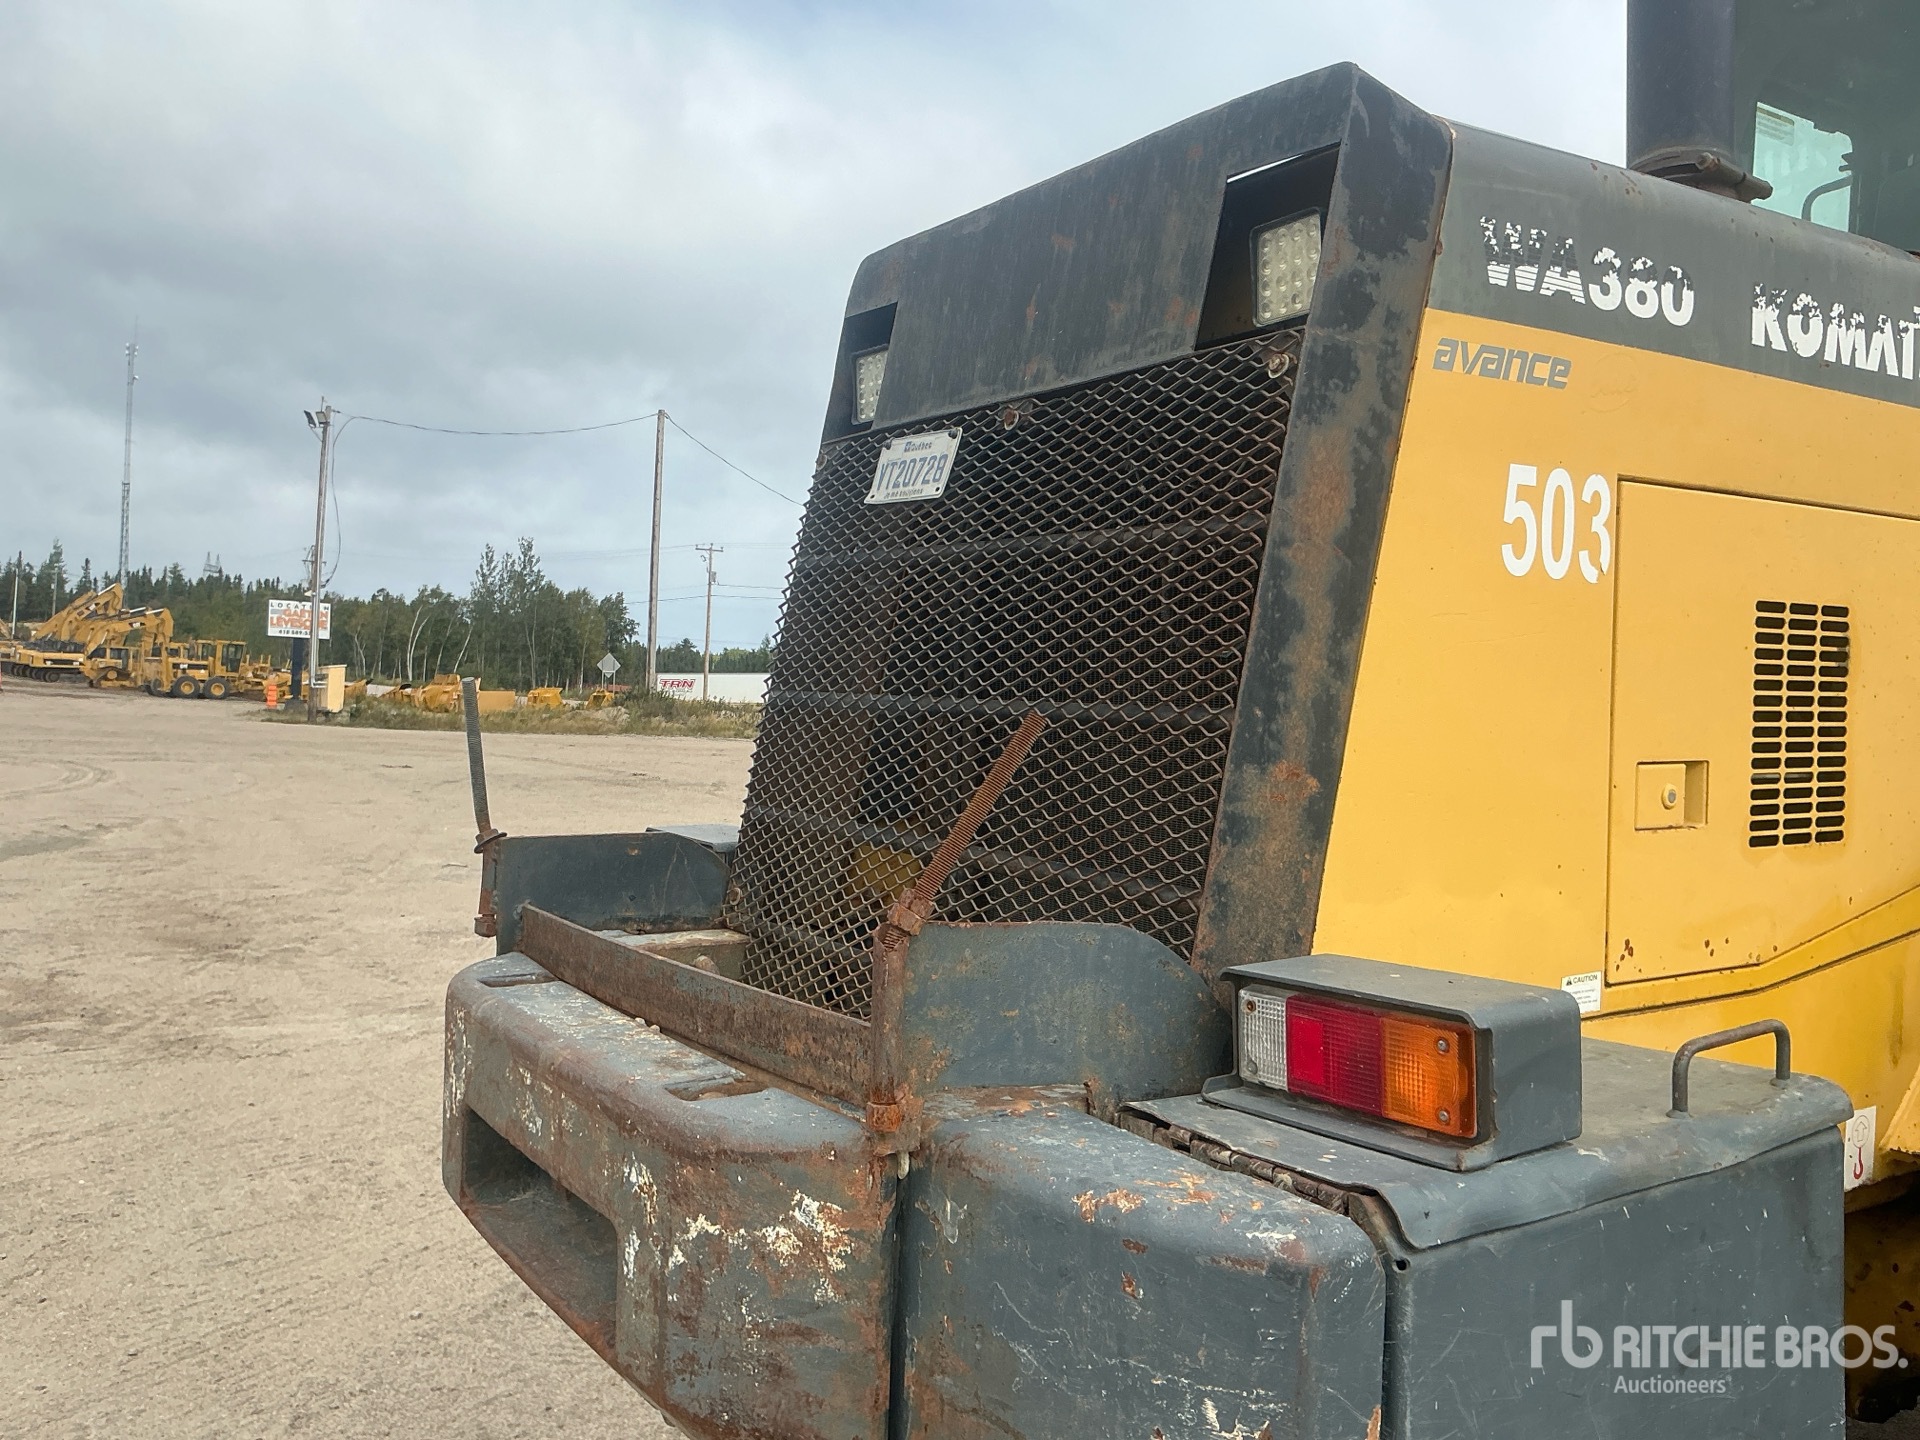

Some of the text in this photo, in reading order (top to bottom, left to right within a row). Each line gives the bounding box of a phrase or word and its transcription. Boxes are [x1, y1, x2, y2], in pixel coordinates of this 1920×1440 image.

[1479, 216, 1694, 327] WA380
[1751, 283, 1920, 380] KOMAT
[1432, 337, 1571, 389] avance
[1502, 464, 1611, 584] 503
[270, 603, 330, 611] LOCATIN
[283, 609, 329, 620] GAETN
[270, 616, 329, 631] LEVESQE
[660, 679, 695, 689] TRN
[1573, 975, 1598, 984] CAUTION
